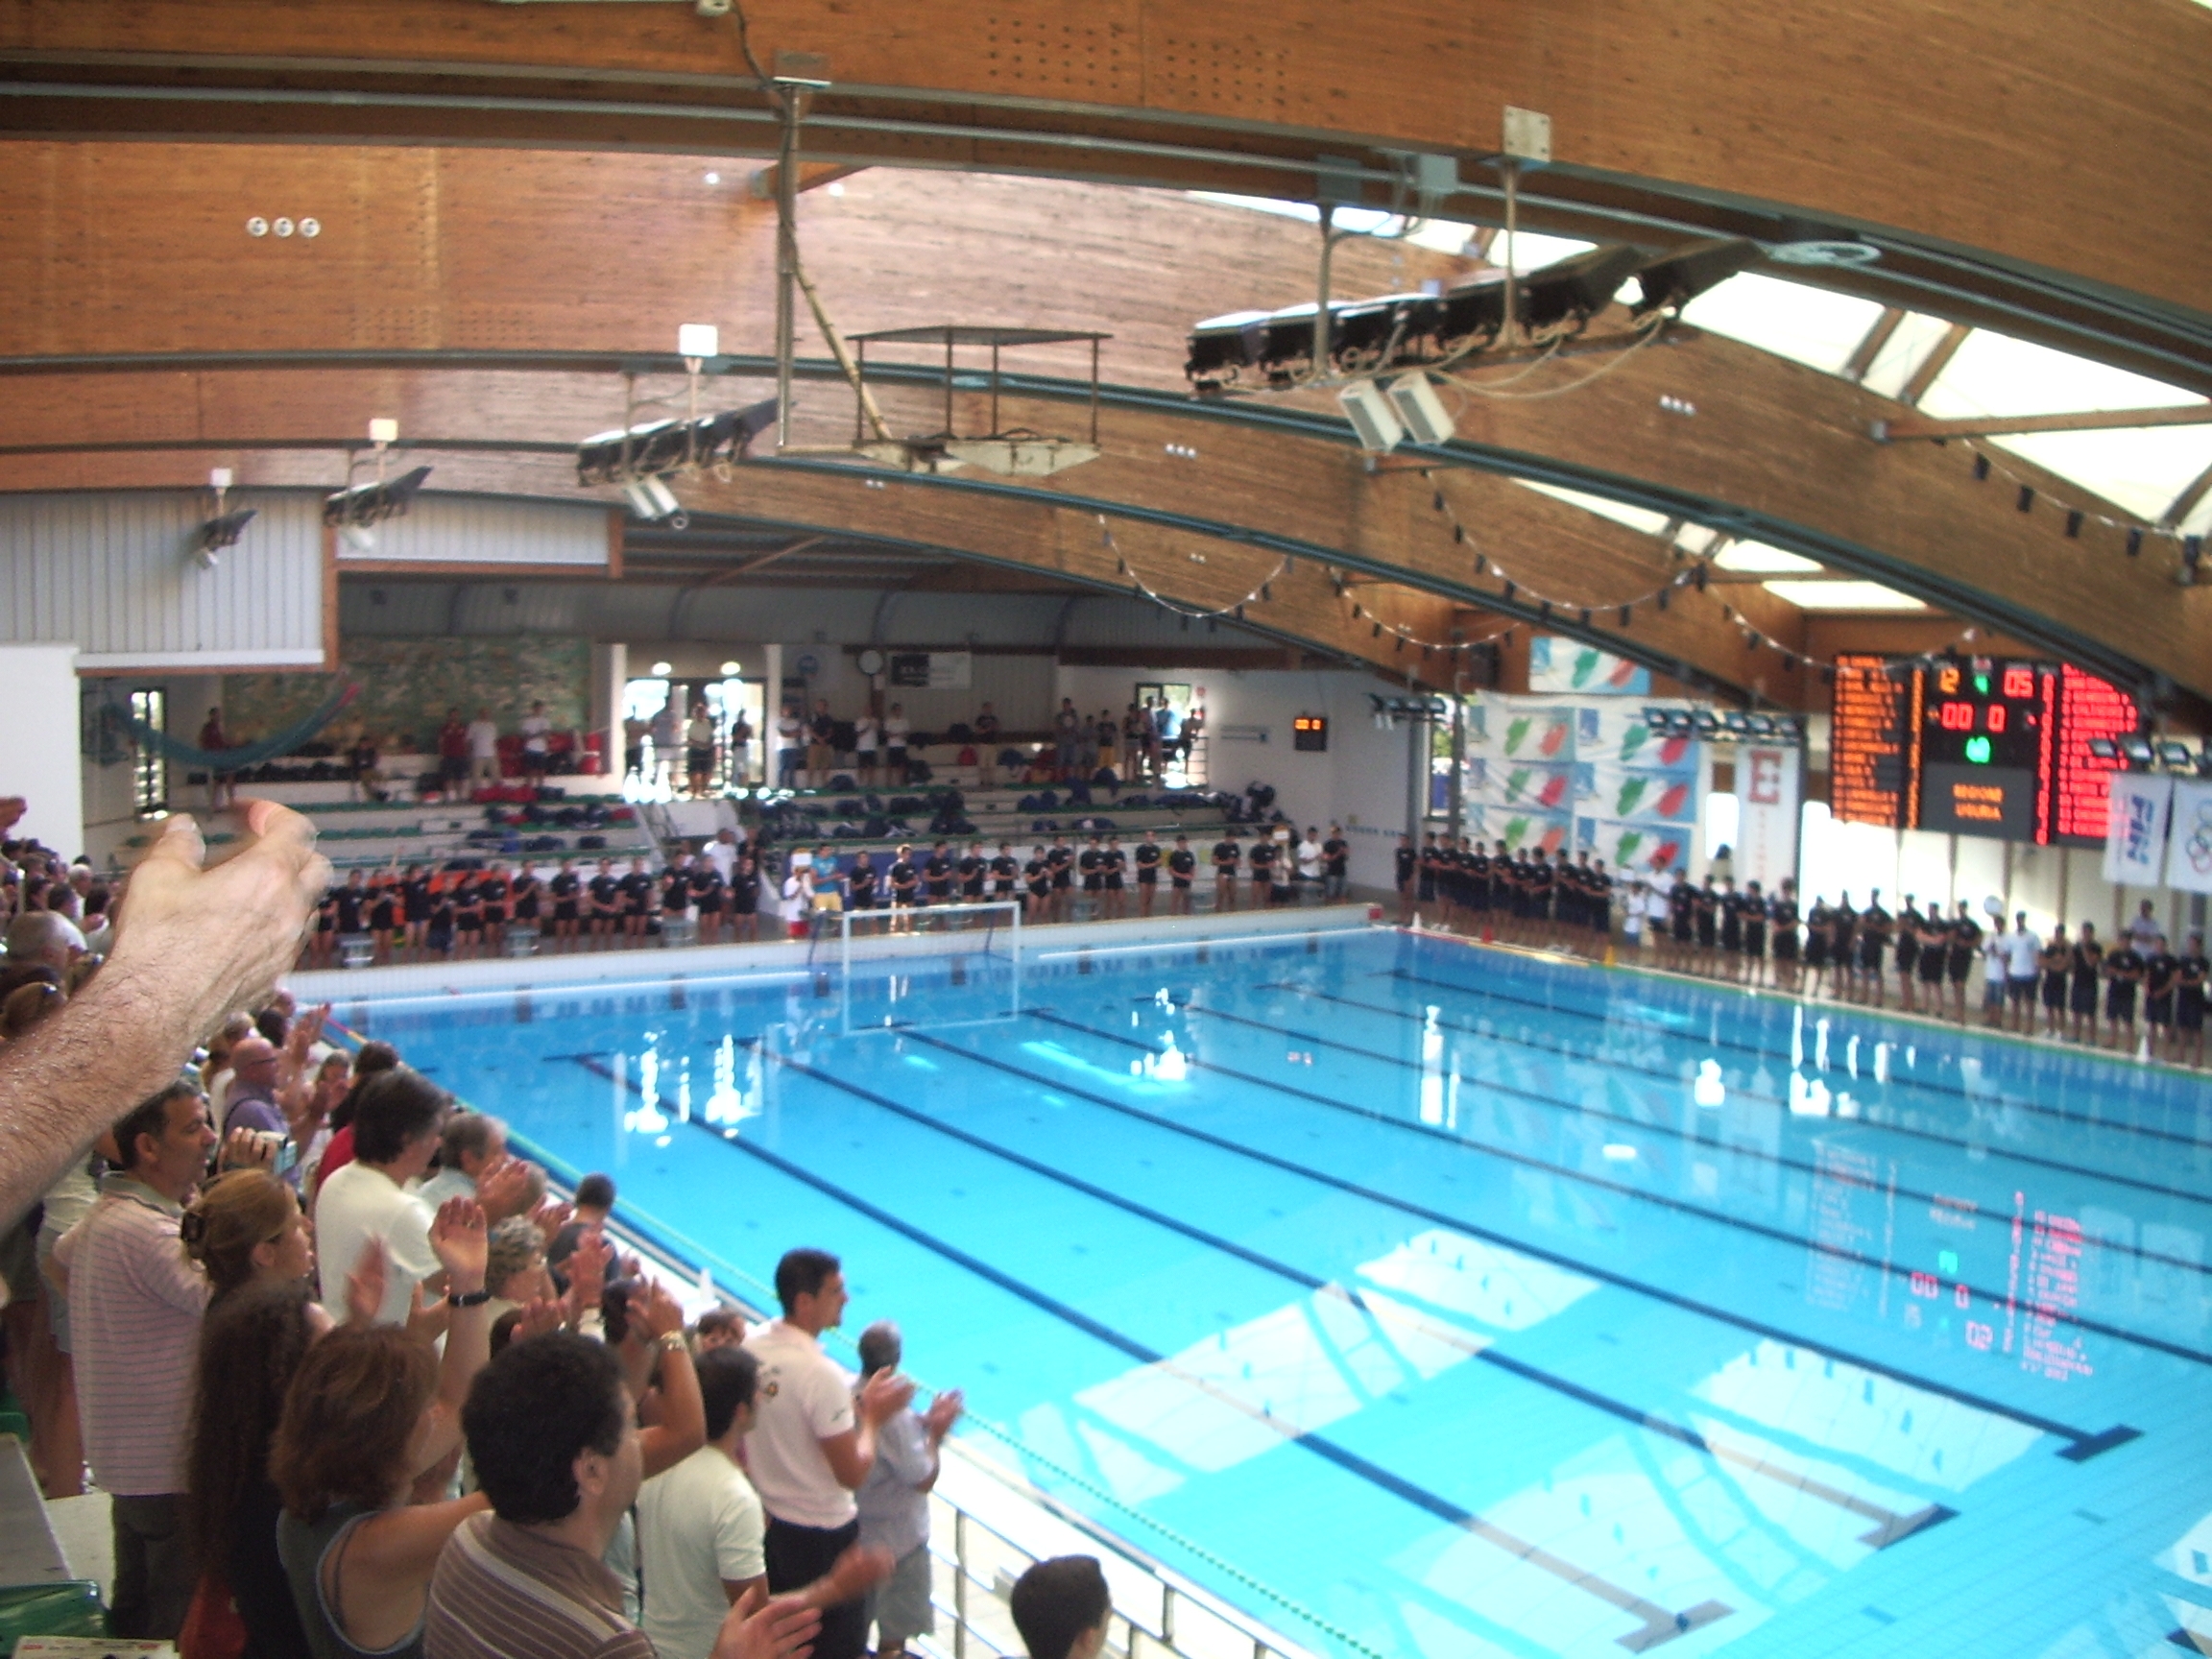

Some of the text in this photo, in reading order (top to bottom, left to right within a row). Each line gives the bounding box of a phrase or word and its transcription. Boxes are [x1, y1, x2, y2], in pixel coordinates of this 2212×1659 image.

[2004, 668, 2033, 698] 05
[1941, 702, 2006, 733] 00 0
